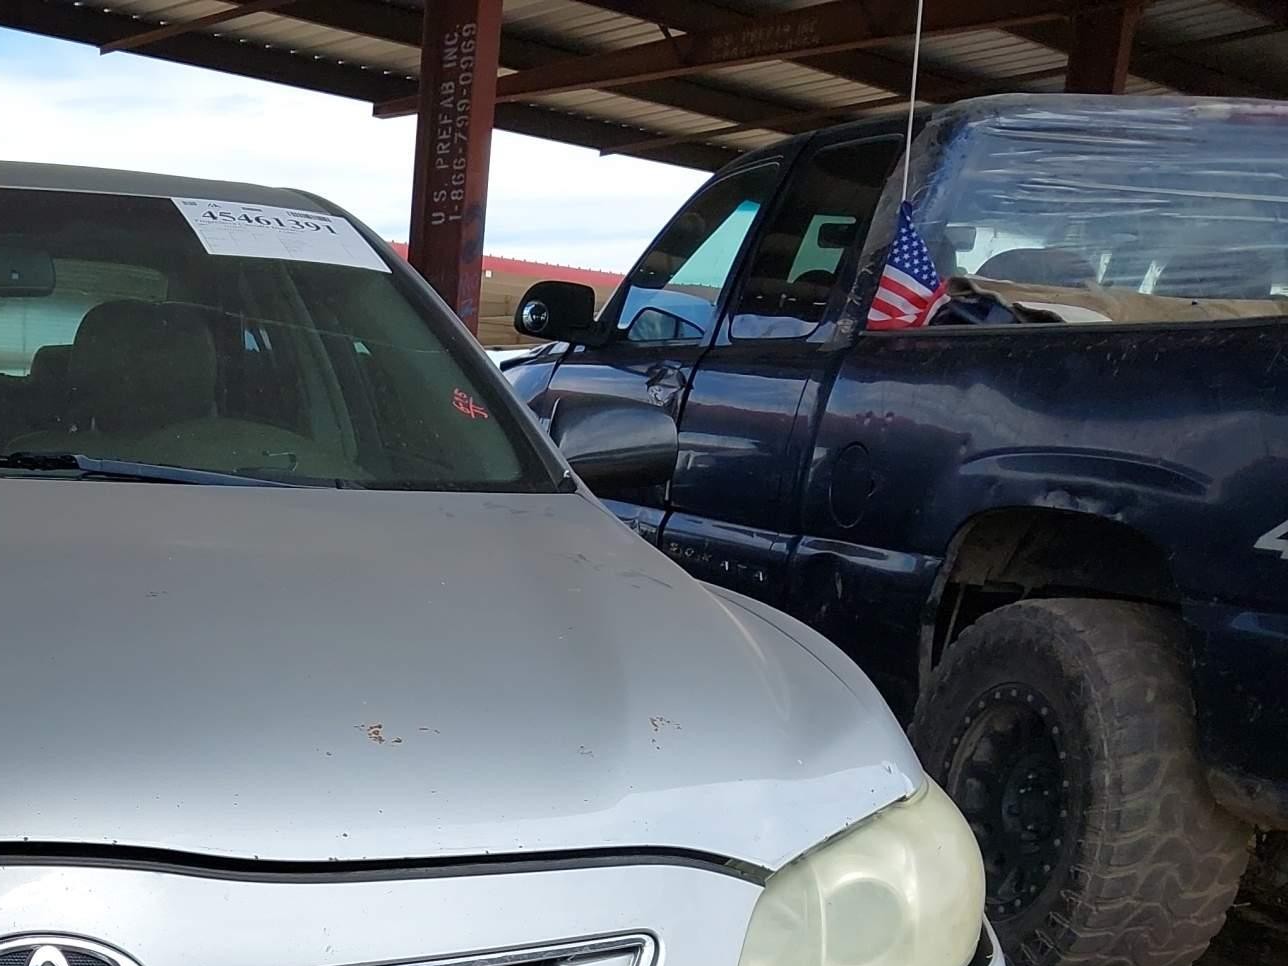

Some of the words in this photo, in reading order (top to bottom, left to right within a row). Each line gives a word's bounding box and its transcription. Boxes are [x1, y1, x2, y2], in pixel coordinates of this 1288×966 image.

[443, 23, 461, 70] INC.
[435, 82, 456, 170] PREFAB
[448, 23, 477, 223] 1-866-799-0969
[201, 208, 338, 236] 45461391
